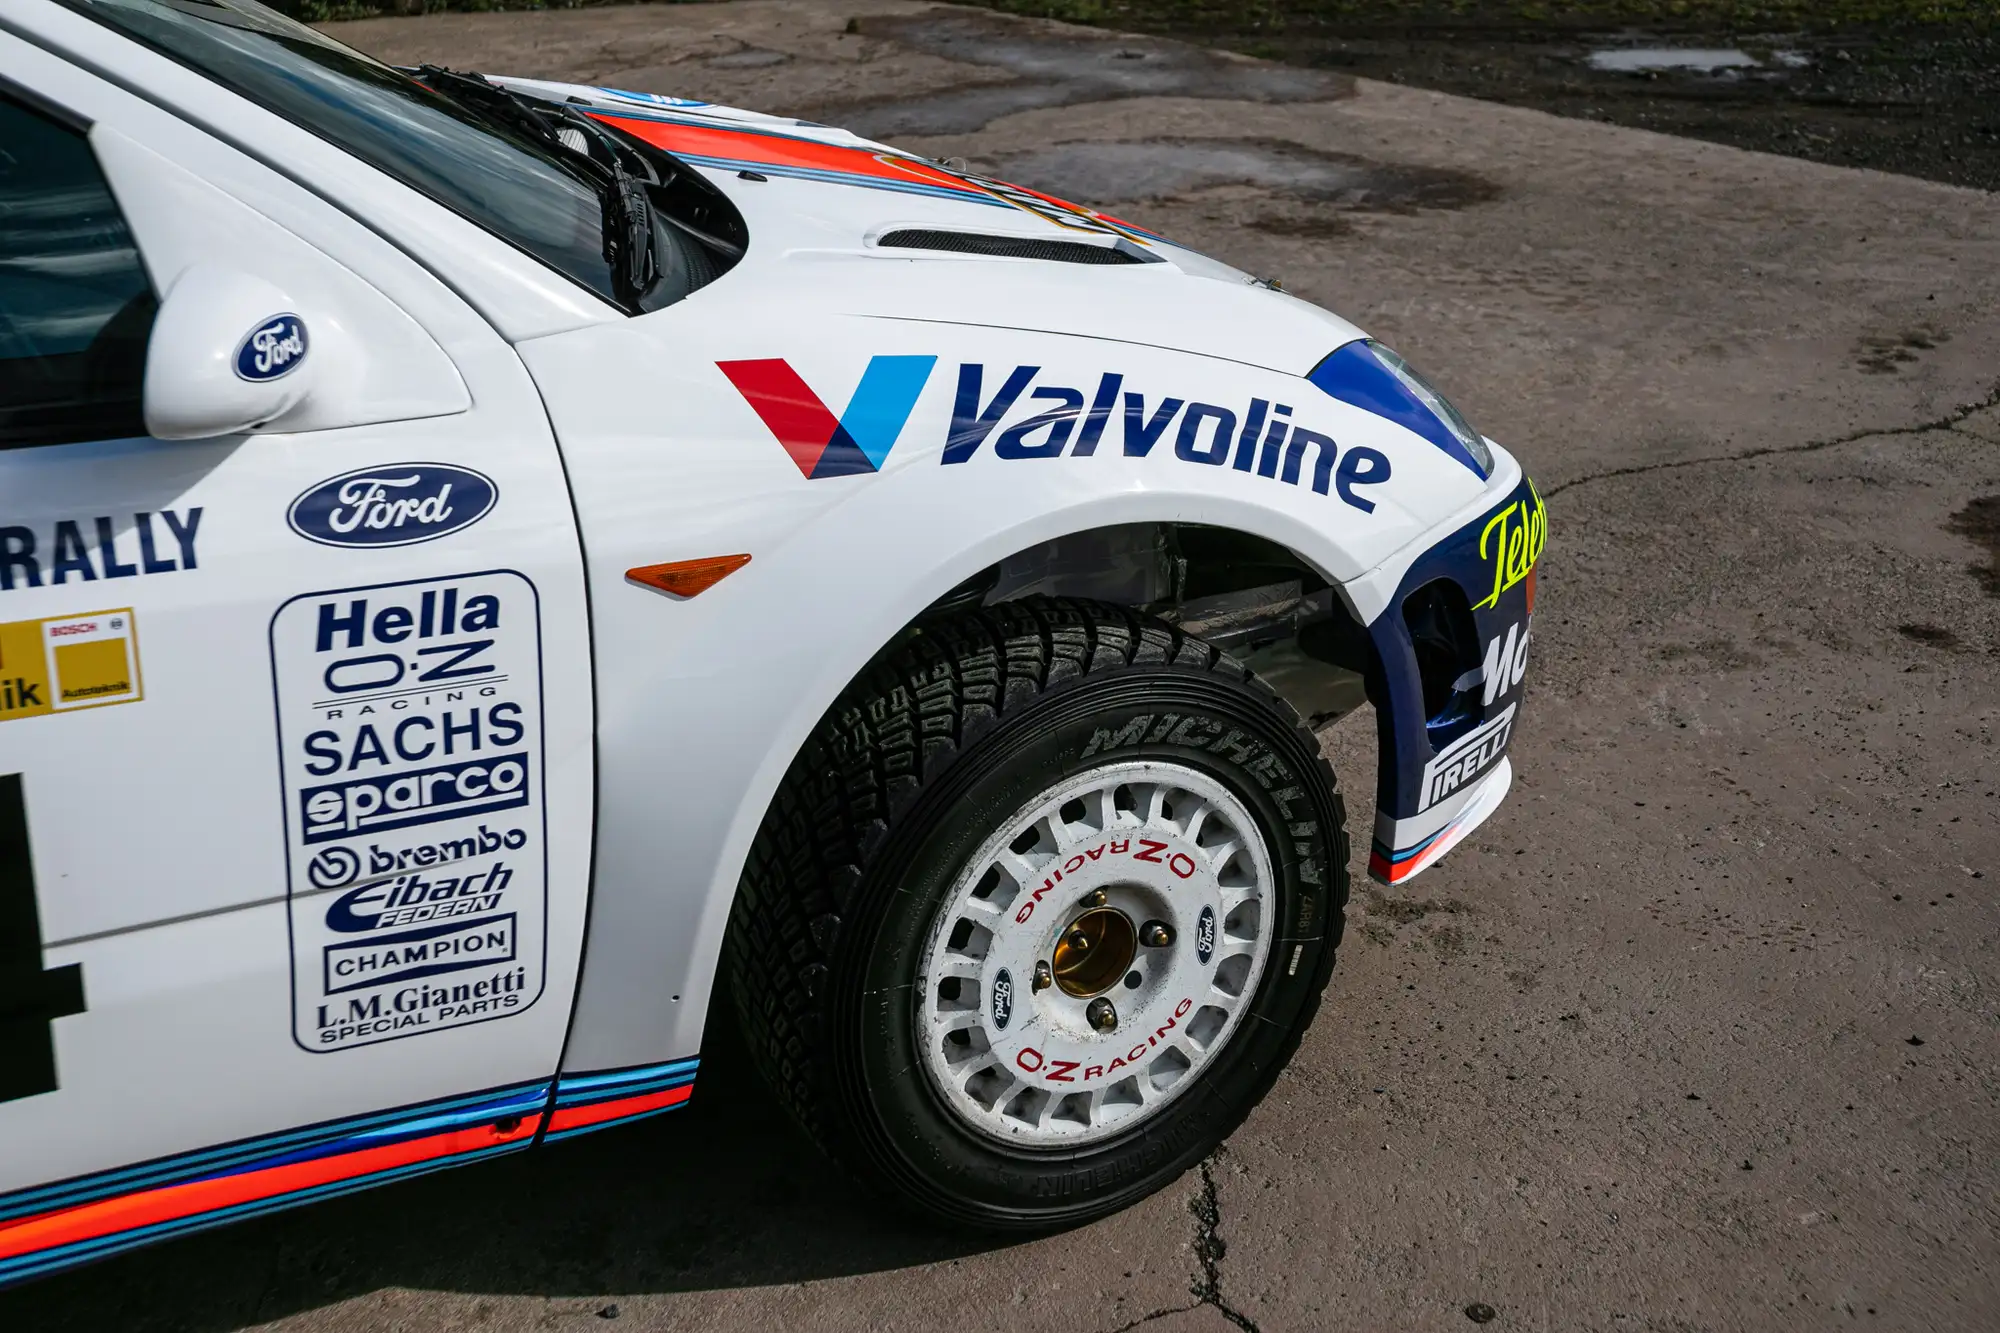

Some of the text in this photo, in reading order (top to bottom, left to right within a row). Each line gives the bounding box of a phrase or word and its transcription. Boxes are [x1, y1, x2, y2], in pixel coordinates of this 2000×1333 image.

[252, 321, 304, 373] Ford
[940, 363, 1393, 515] Valvoline
[328, 474, 453, 533] Ford
[0, 507, 204, 591] RALLY
[315, 588, 500, 652] Hella
[326, 686, 497, 720] RACING
[303, 702, 525, 776] SACHS
[1418, 701, 1517, 814] PIRELLI
[306, 760, 525, 832] sparco
[1079, 713, 1324, 886] MICHELIN
[370, 825, 527, 875] brembo
[1014, 838, 1131, 925] RACING
[325, 862, 514, 933] Eibach
[374, 893, 500, 929] FEDERN
[335, 930, 505, 977] CHAMPION
[1198, 916, 1214, 953] Ford
[319, 994, 519, 1044] SPECIAL PARTS
[994, 981, 1011, 1020] Ford
[1083, 997, 1193, 1081] RACING
